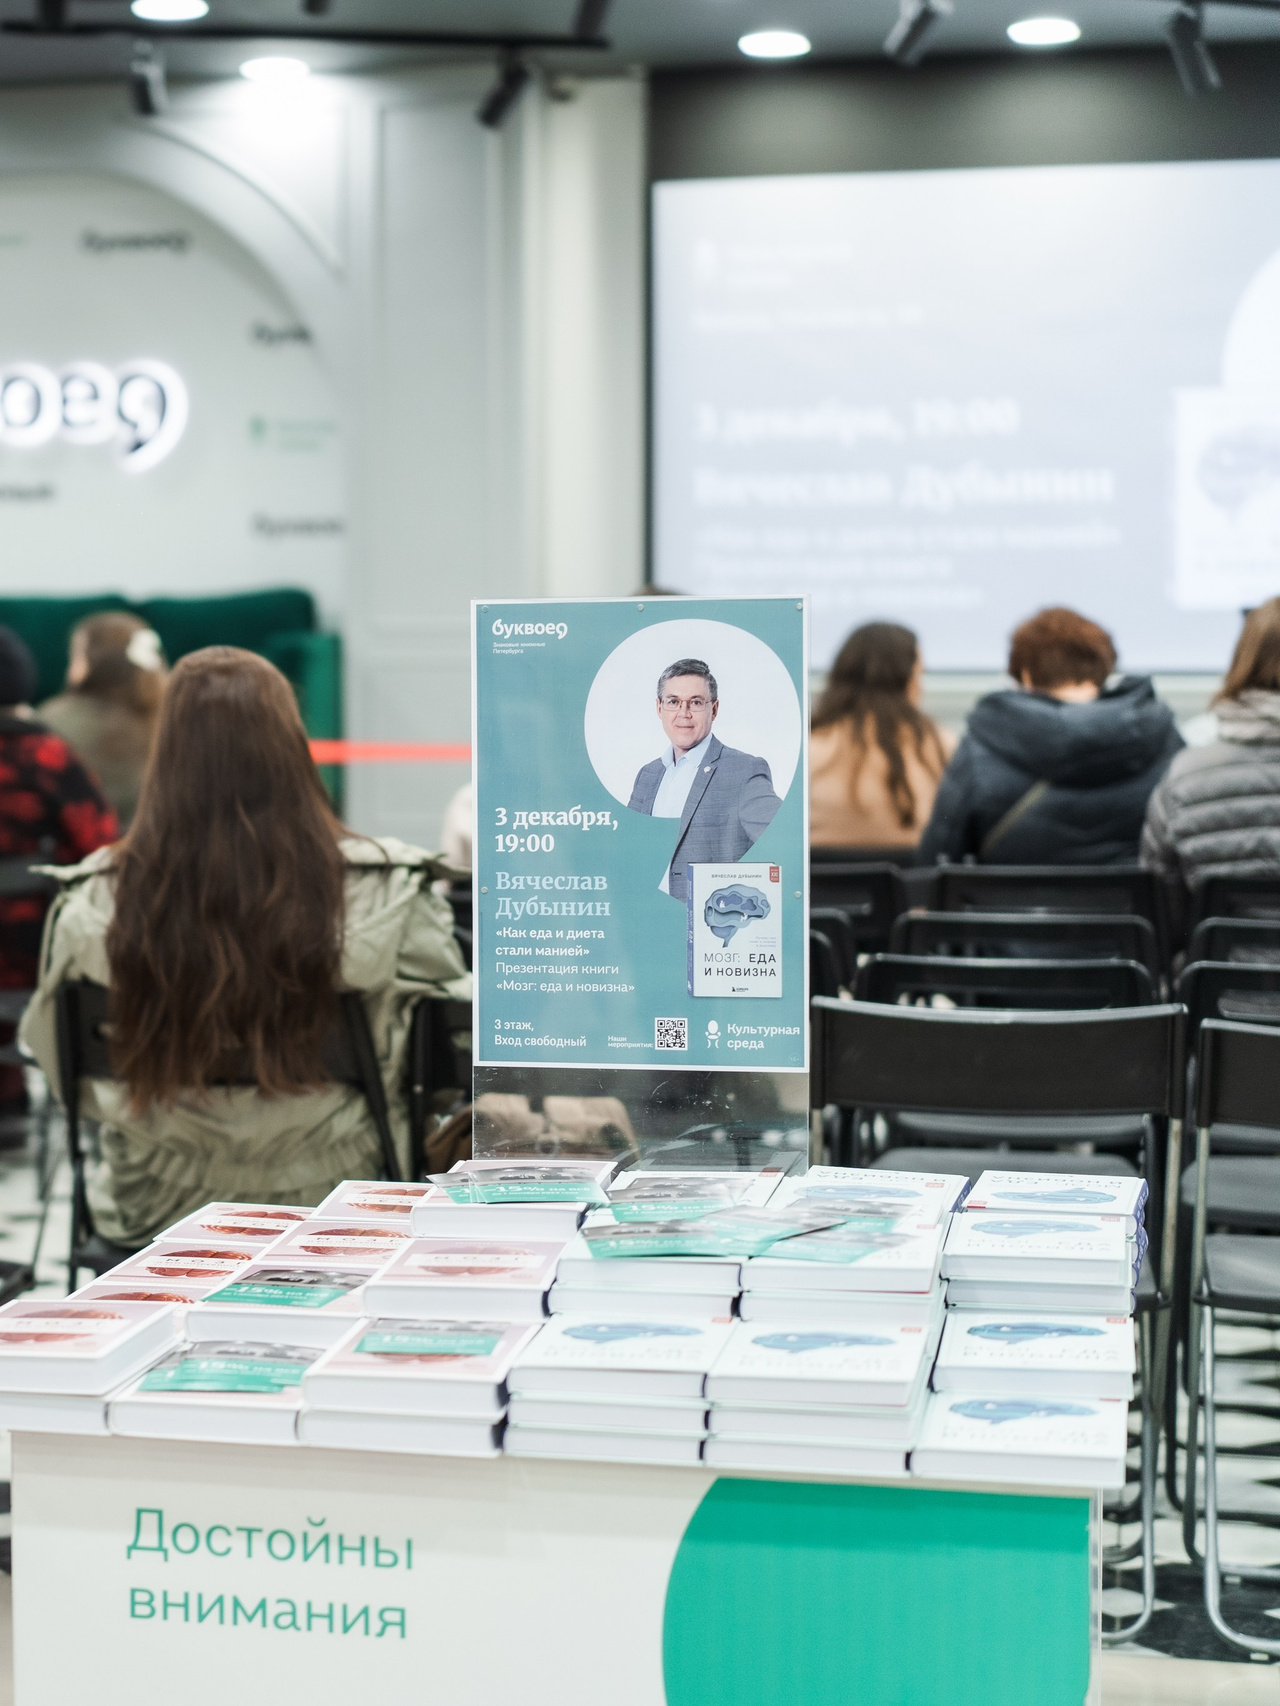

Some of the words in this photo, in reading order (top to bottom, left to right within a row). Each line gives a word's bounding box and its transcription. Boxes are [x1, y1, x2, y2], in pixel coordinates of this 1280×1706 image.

[492, 618, 568, 640] буквоед
[495, 807, 508, 826] 3
[513, 804, 619, 831] декабря,
[495, 834, 555, 853] 19:00
[495, 871, 608, 890] Вячеслав
[495, 895, 611, 921] Дубынин
[496, 926, 527, 938] «Как
[529, 929, 552, 940] еда
[556, 930, 564, 938] и
[566, 929, 605, 940] диета
[495, 946, 532, 956] стали
[535, 945, 590, 956] манией»
[704, 953, 740, 962] МОЗГ:
[749, 953, 777, 964] ЕДА
[496, 962, 579, 976] Презентация
[581, 965, 619, 974] книги
[704, 967, 712, 976] И
[716, 968, 776, 977] НОВИЗНА
[496, 980, 537, 991] «Мозг:
[540, 982, 562, 993] еда
[565, 983, 573, 991] и
[576, 983, 635, 993] новизна»
[494, 1019, 501, 1030] 3
[504, 1020, 534, 1031] этаж,
[727, 1023, 800, 1037] Культурная
[494, 1034, 522, 1047] Вход
[524, 1035, 587, 1047] свободный
[727, 1039, 765, 1051] среда
[127, 1507, 413, 1570] Достойны
[129, 1587, 407, 1639] внимания
